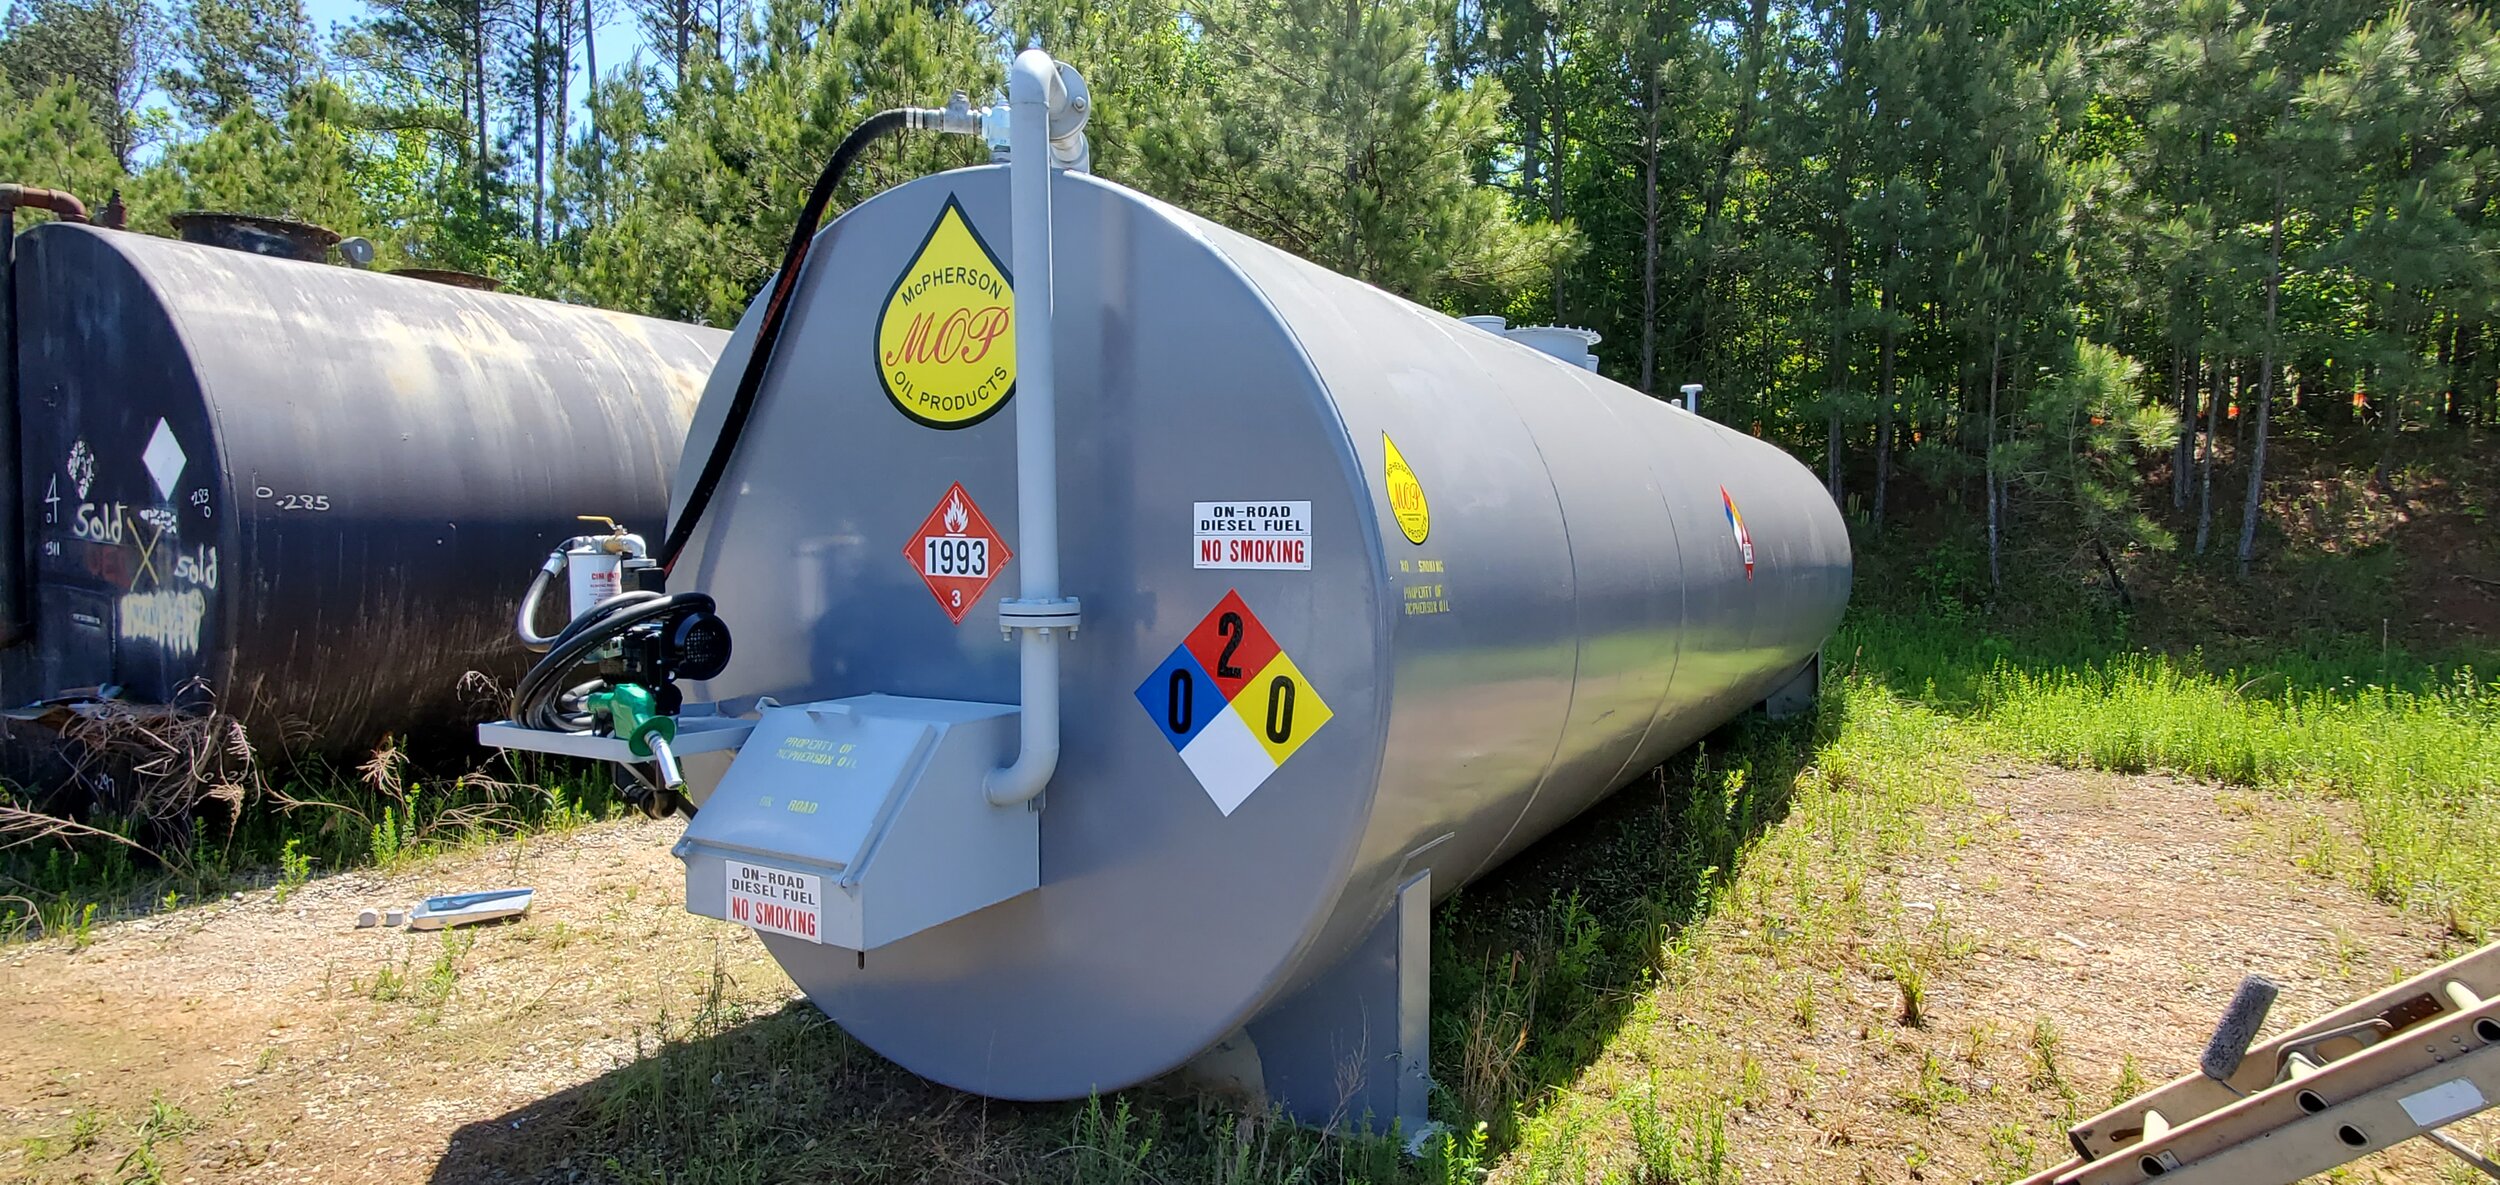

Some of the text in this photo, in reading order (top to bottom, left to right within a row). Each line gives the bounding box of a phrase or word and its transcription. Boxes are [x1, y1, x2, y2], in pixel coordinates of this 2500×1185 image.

[901, 267, 1003, 306] McPHERSON
[886, 306, 1010, 367] MOP
[894, 366, 1007, 412] OIL PRODUCTS
[73, 501, 128, 545] Sold
[1213, 505, 1291, 518] ON-ROAD
[1201, 519, 1304, 532] DIESEL FUEL
[928, 539, 986, 576] 1993
[1201, 539, 1304, 564] NO SMOKING
[1400, 559, 1444, 573] NO SMOKING
[951, 589, 962, 608] 3
[1403, 584, 1442, 600] PROPERTY OF
[1439, 600, 1450, 613] OIL
[1216, 611, 1244, 679] 2
[1168, 668, 1296, 745] 0 0
[784, 736, 857, 754] PROPERTY OF
[837, 755, 857, 769] OIL
[787, 799, 818, 815] ROAD
[742, 867, 805, 890] ON-ROAD
[732, 878, 816, 906] DIESEL FUEL
[732, 896, 816, 937] NO SMOKING
